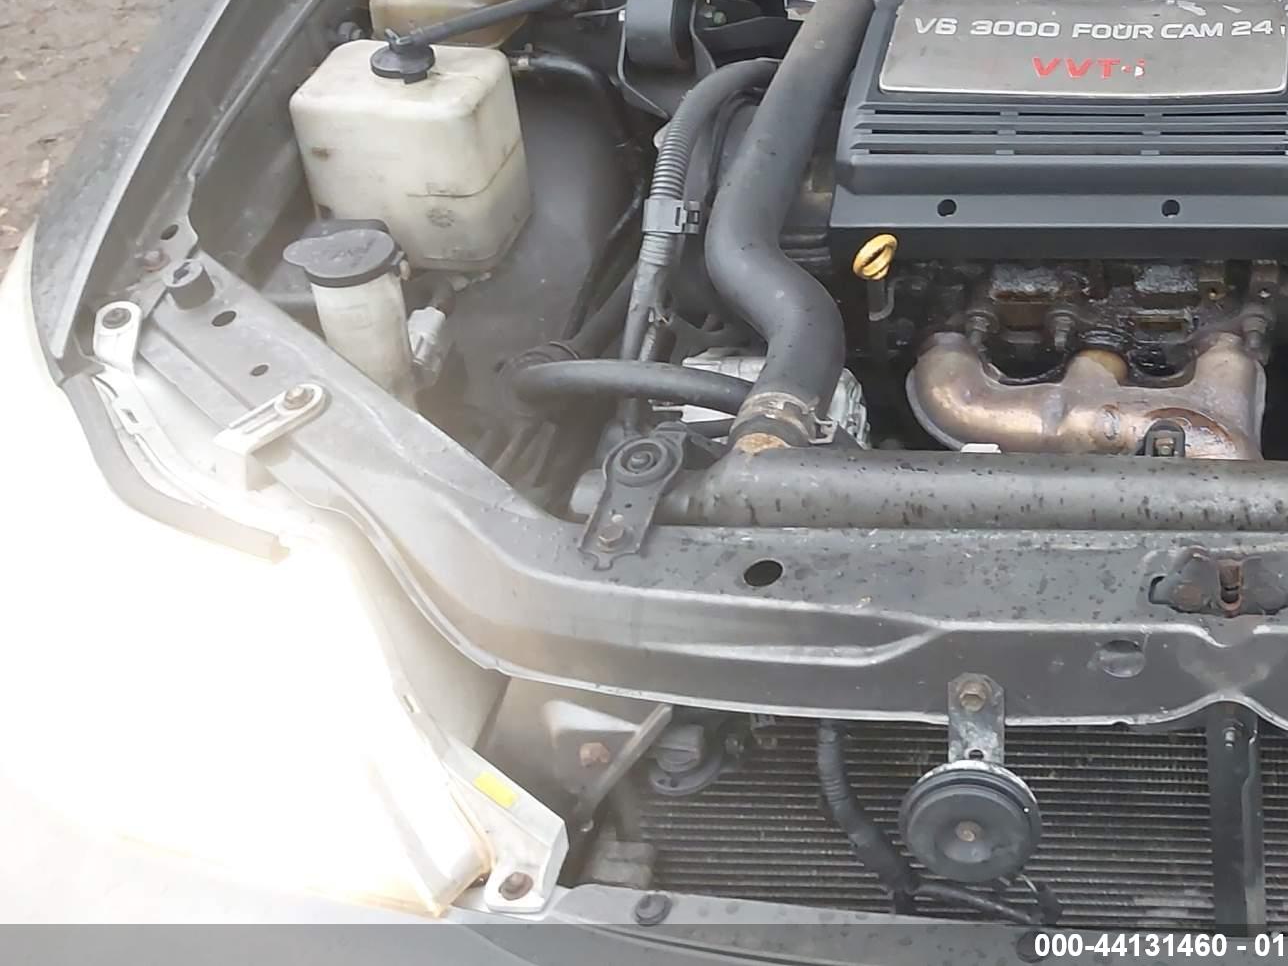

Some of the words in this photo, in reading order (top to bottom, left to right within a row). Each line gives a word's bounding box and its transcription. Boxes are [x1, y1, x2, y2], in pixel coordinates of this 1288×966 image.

[914, 17, 958, 35] V6
[969, 19, 1061, 38] 3000
[1071, 22, 1154, 40] FOUR
[1160, 22, 1224, 39] CAM
